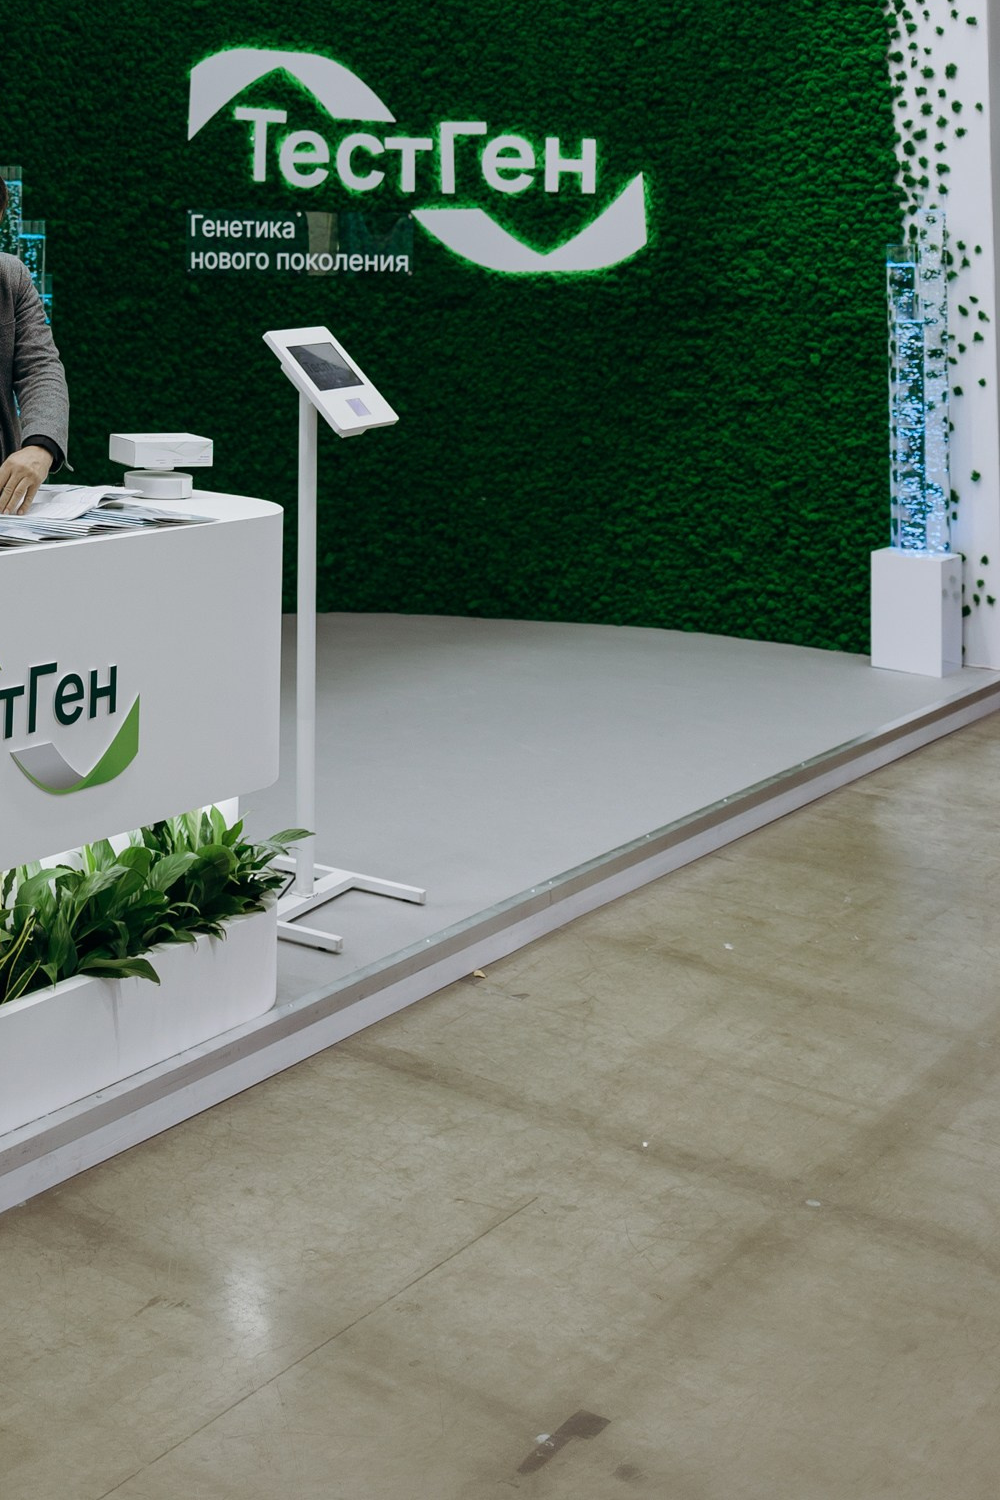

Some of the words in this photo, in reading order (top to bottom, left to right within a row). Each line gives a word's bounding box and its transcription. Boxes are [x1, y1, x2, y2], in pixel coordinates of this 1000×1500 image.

[234, 106, 597, 194] ТестГен
[190, 214, 295, 239] Генетика
[190, 250, 270, 271] нового
[276, 250, 410, 273] поколения
